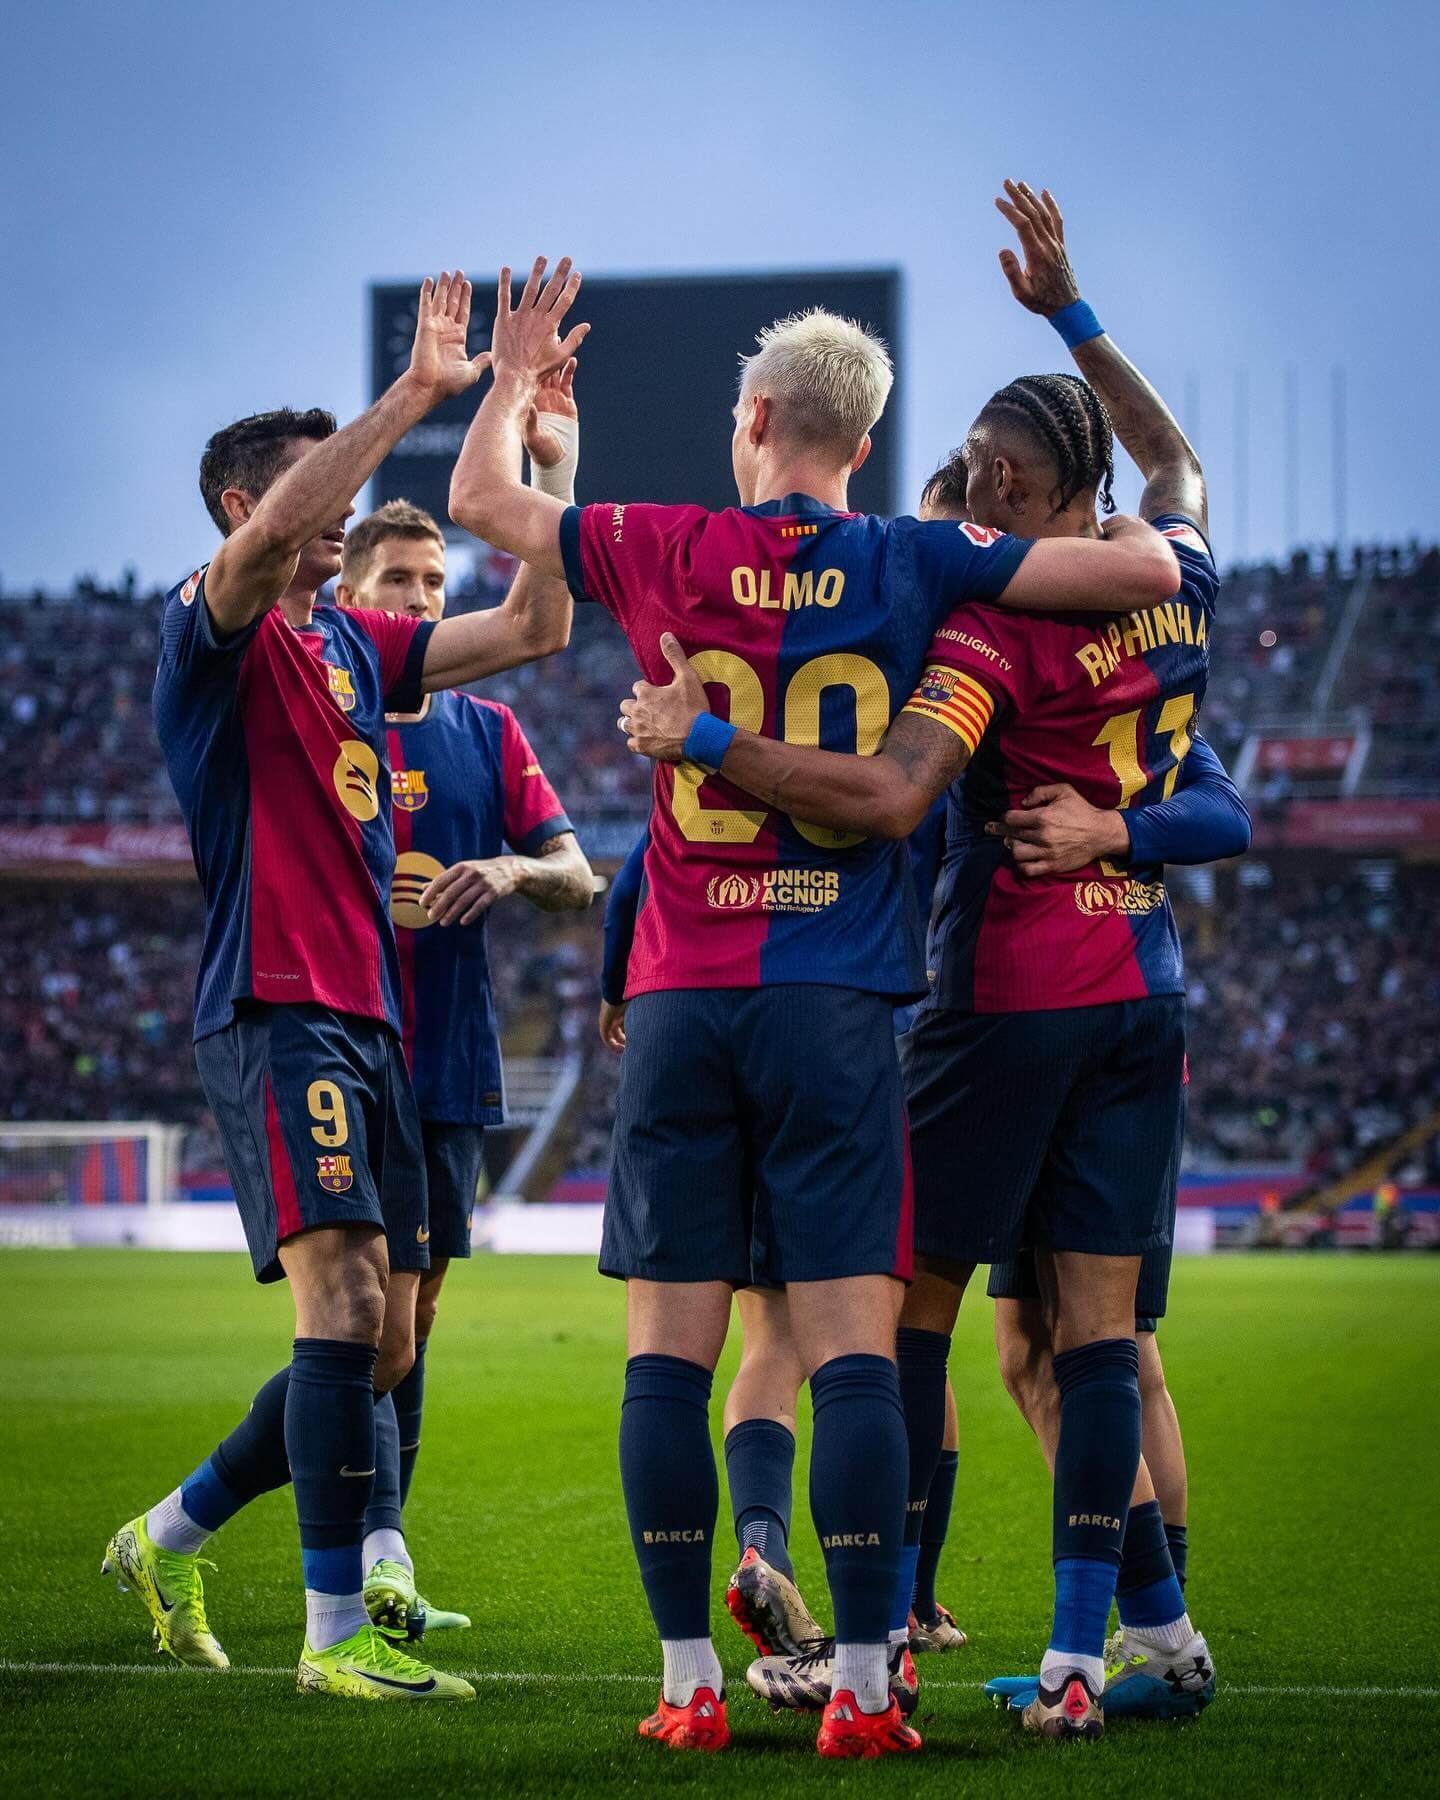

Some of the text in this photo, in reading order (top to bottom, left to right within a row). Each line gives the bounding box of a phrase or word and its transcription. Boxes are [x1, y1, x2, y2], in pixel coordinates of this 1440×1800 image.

[731, 566, 845, 611] OLMO
[935, 628, 1013, 671] AMBILIGHT tv
[1074, 602, 1207, 688] RAPHINHA
[671, 649, 890, 849] 20
[763, 869, 839, 889] UNHCR
[761, 886, 839, 906] ACNUP
[761, 903, 775, 911] The
[307, 1080, 349, 1148] 9
[1068, 1514, 1120, 1531] BARÇA
[643, 1529, 705, 1545] BARÇA
[823, 1532, 881, 1549] BARÇA
